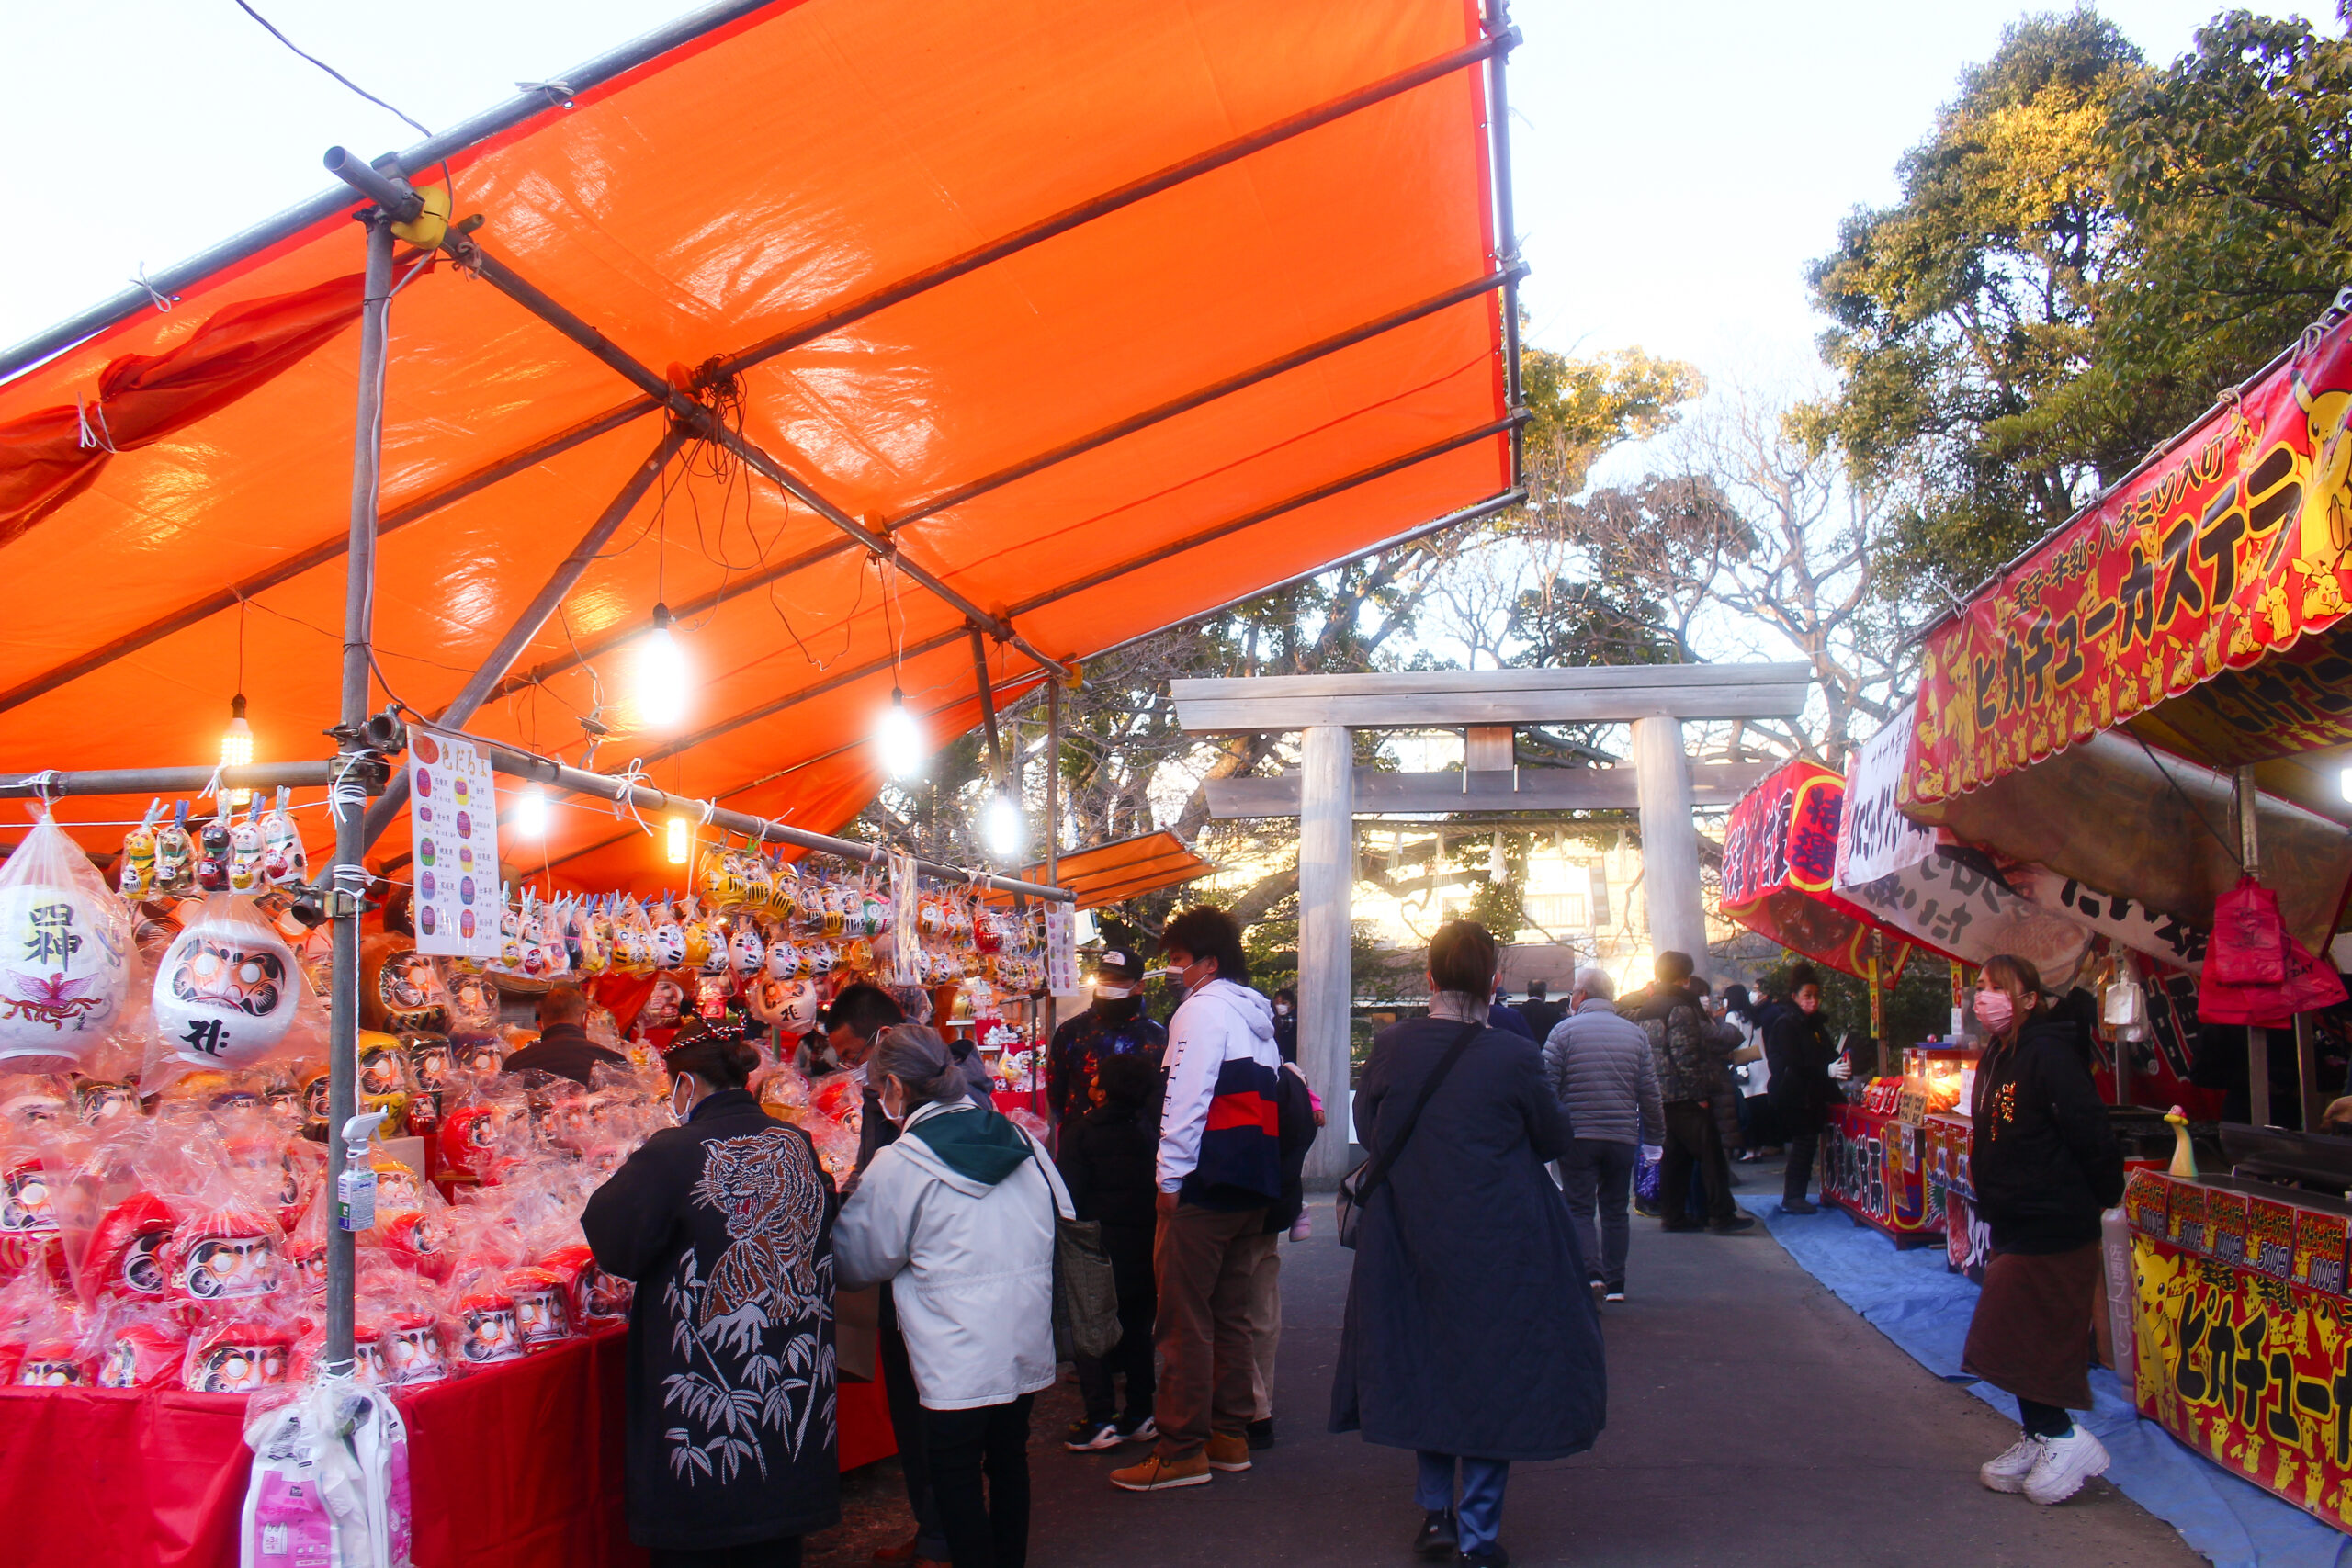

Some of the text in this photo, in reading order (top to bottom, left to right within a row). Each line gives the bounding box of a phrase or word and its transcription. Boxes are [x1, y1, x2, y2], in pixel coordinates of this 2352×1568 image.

[24, 904, 83, 972] 四神
[2257, 1241, 2289, 1278] 500円
[2308, 1256, 2341, 1294] 1000円
